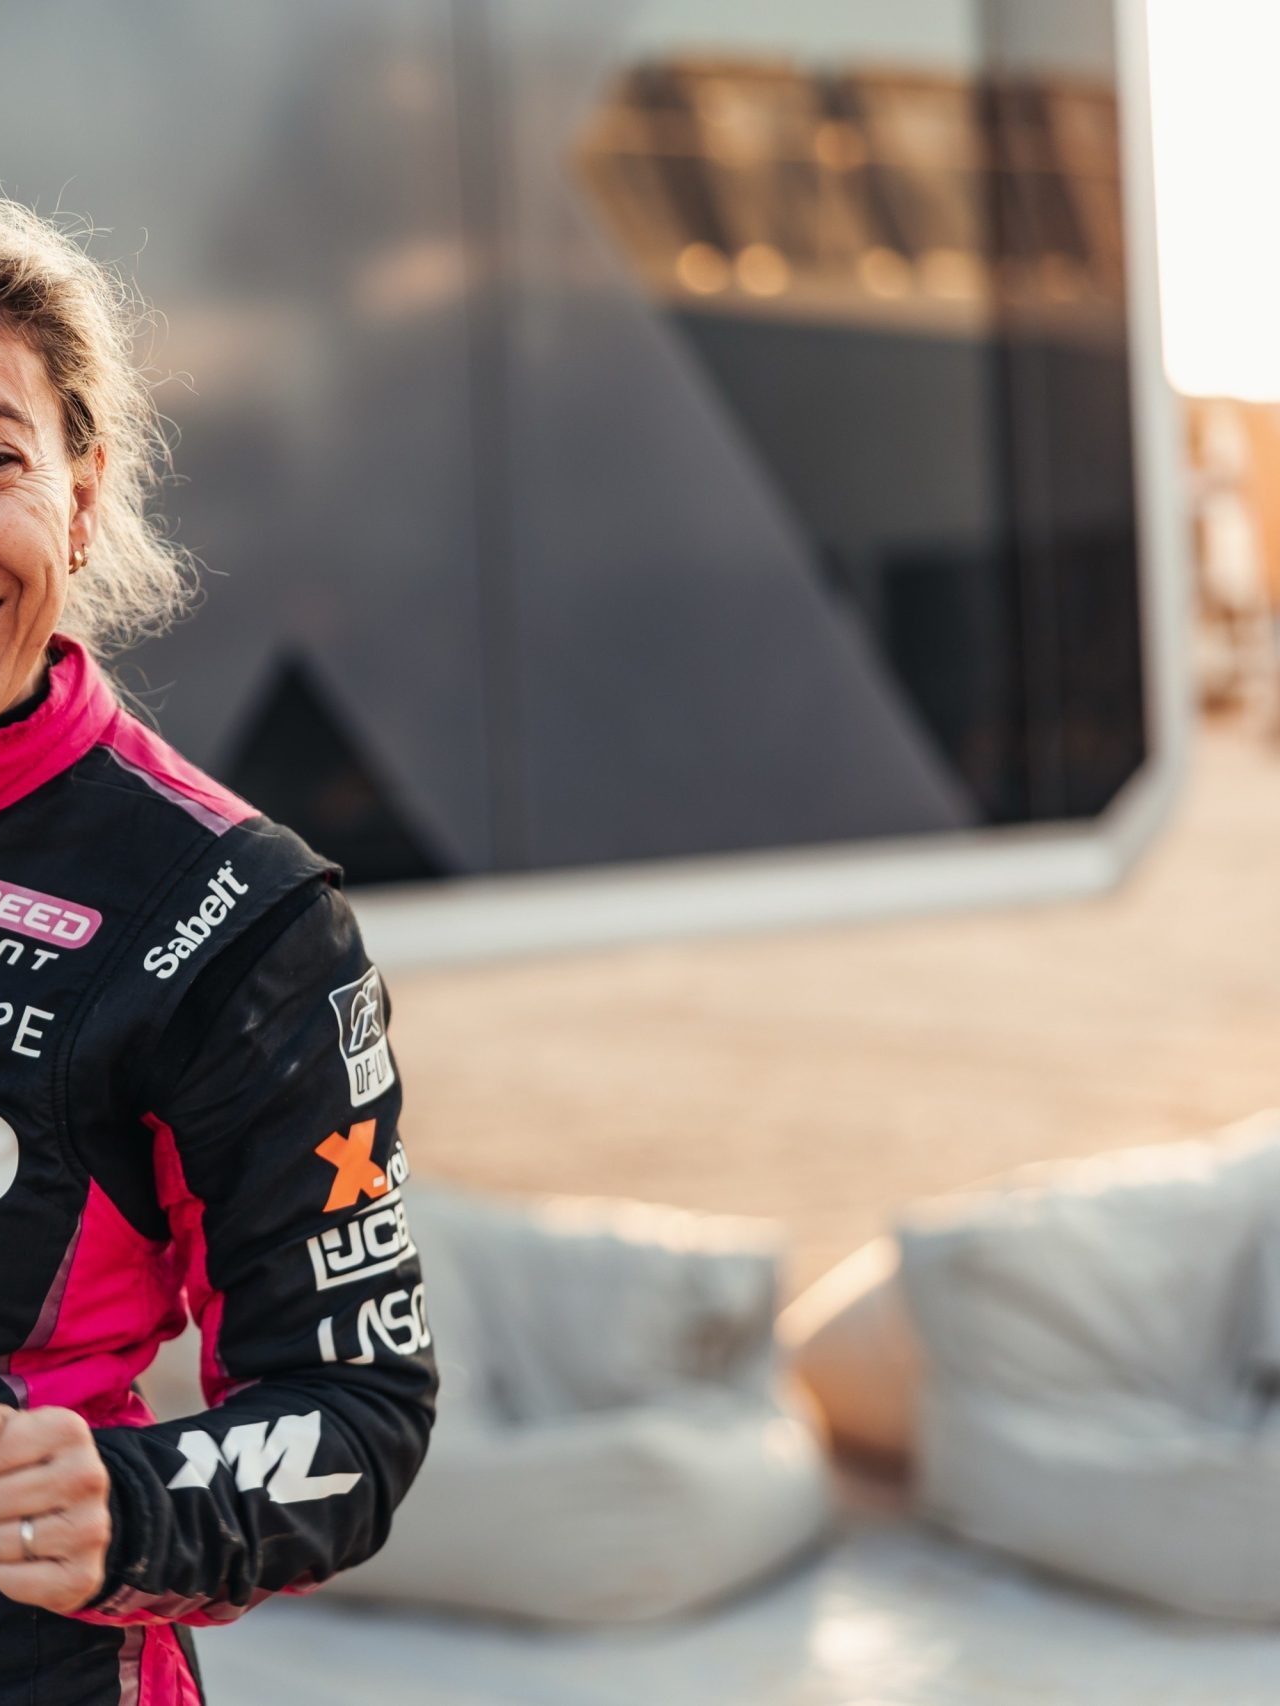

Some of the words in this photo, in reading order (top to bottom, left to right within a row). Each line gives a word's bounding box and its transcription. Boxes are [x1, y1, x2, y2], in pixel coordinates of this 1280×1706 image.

[143, 862, 249, 979] Sabelt
[323, 1201, 408, 1272] JCB
[318, 1283, 432, 1365] LASO
